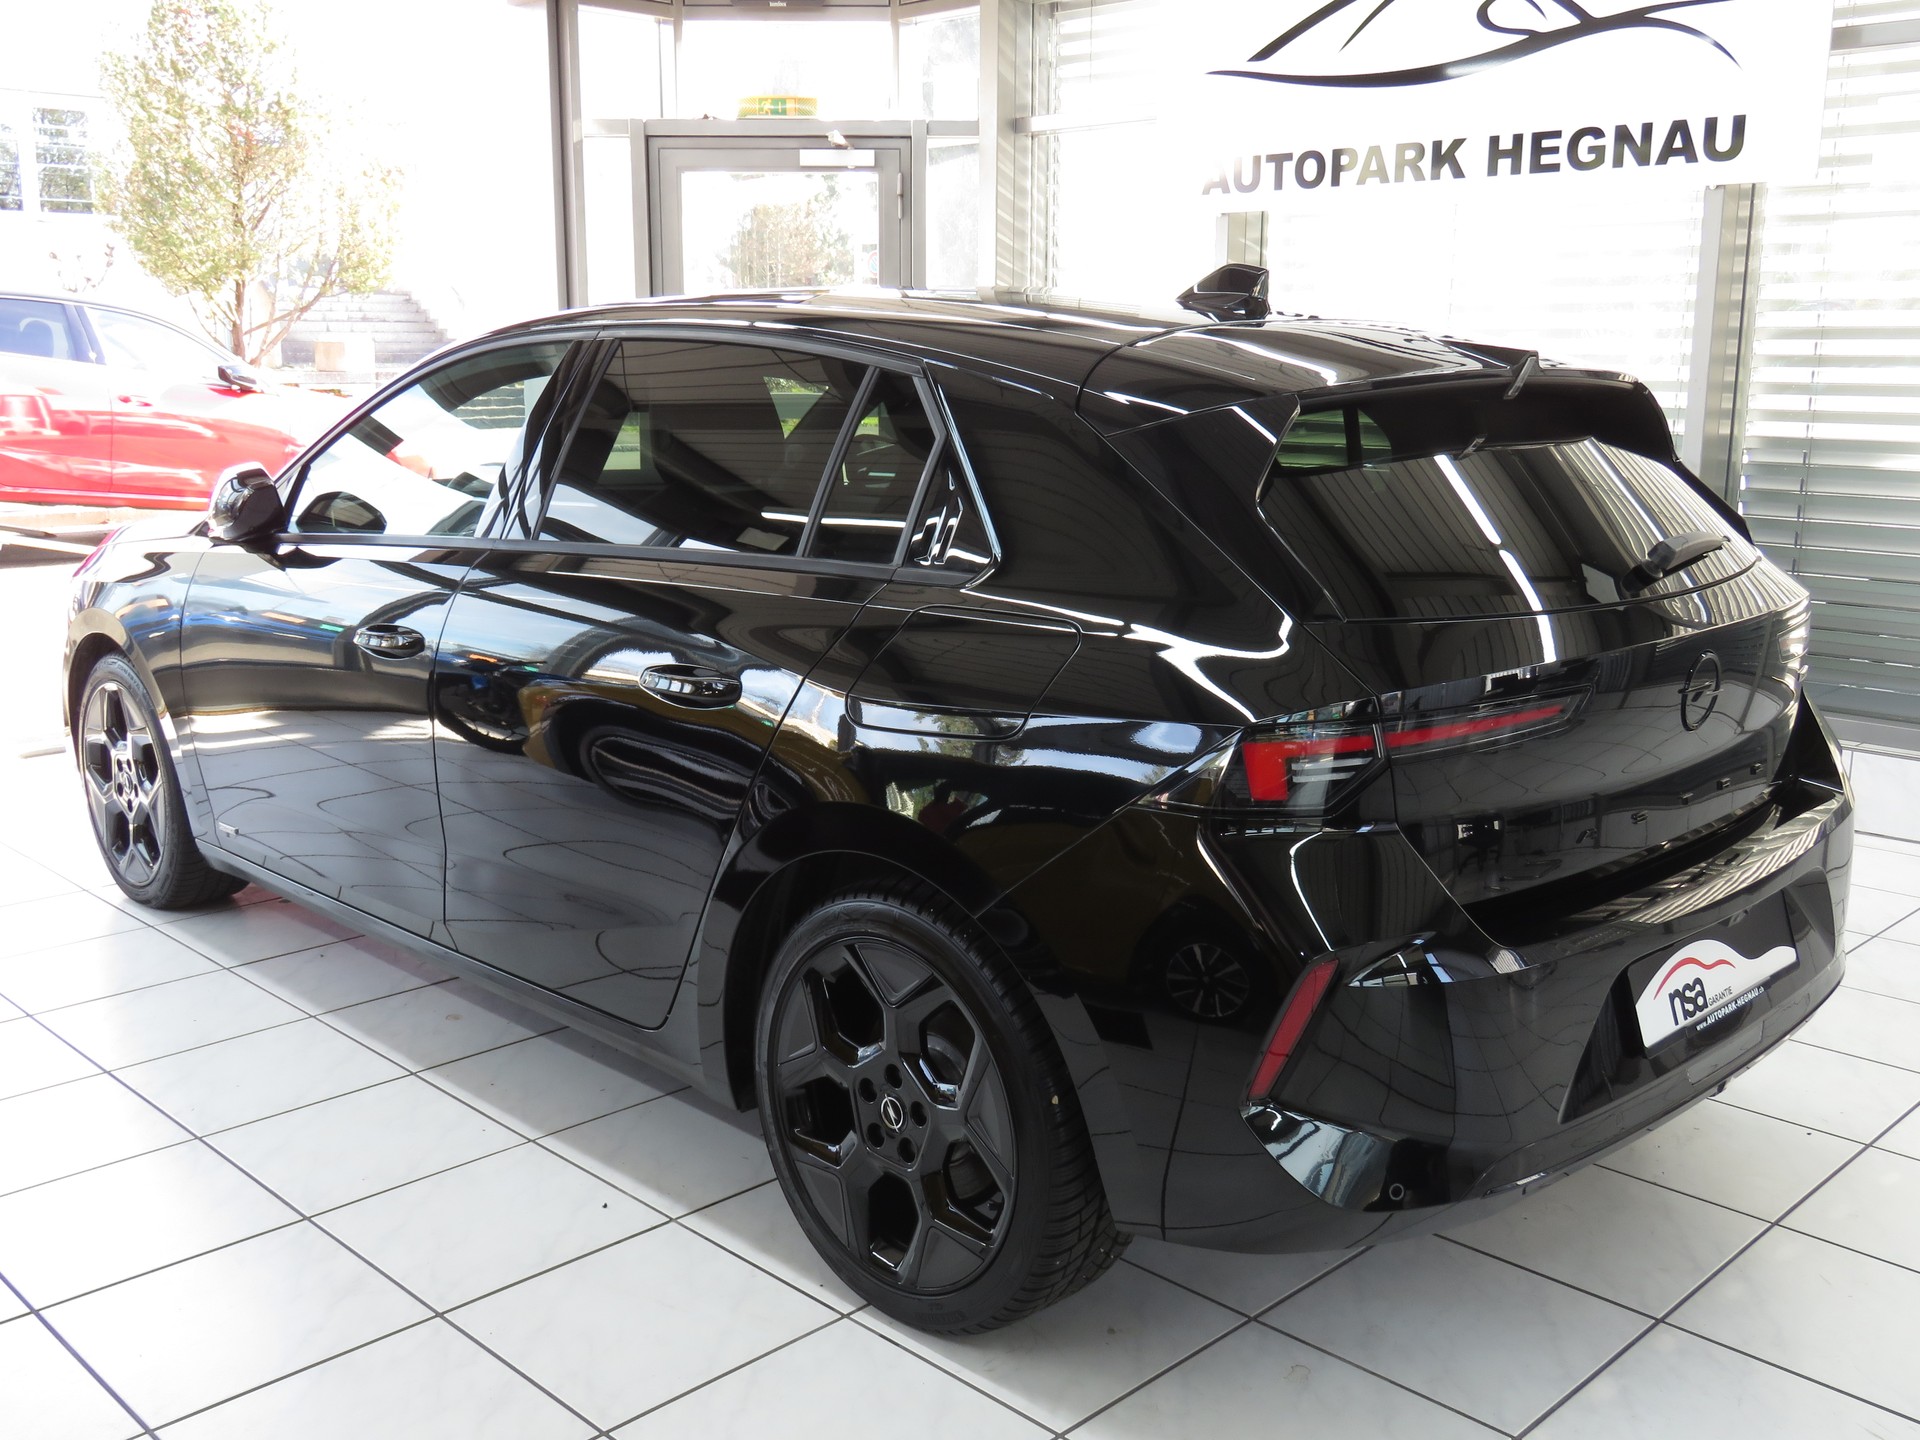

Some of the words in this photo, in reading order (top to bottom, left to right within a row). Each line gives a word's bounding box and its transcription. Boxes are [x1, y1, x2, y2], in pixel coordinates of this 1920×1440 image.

[1202, 138, 1467, 195] AUTOPARK
[1487, 114, 1747, 177] HEGNAU
[1668, 977, 1708, 1026] nsa
[1708, 985, 1733, 1007] GARANTIE
